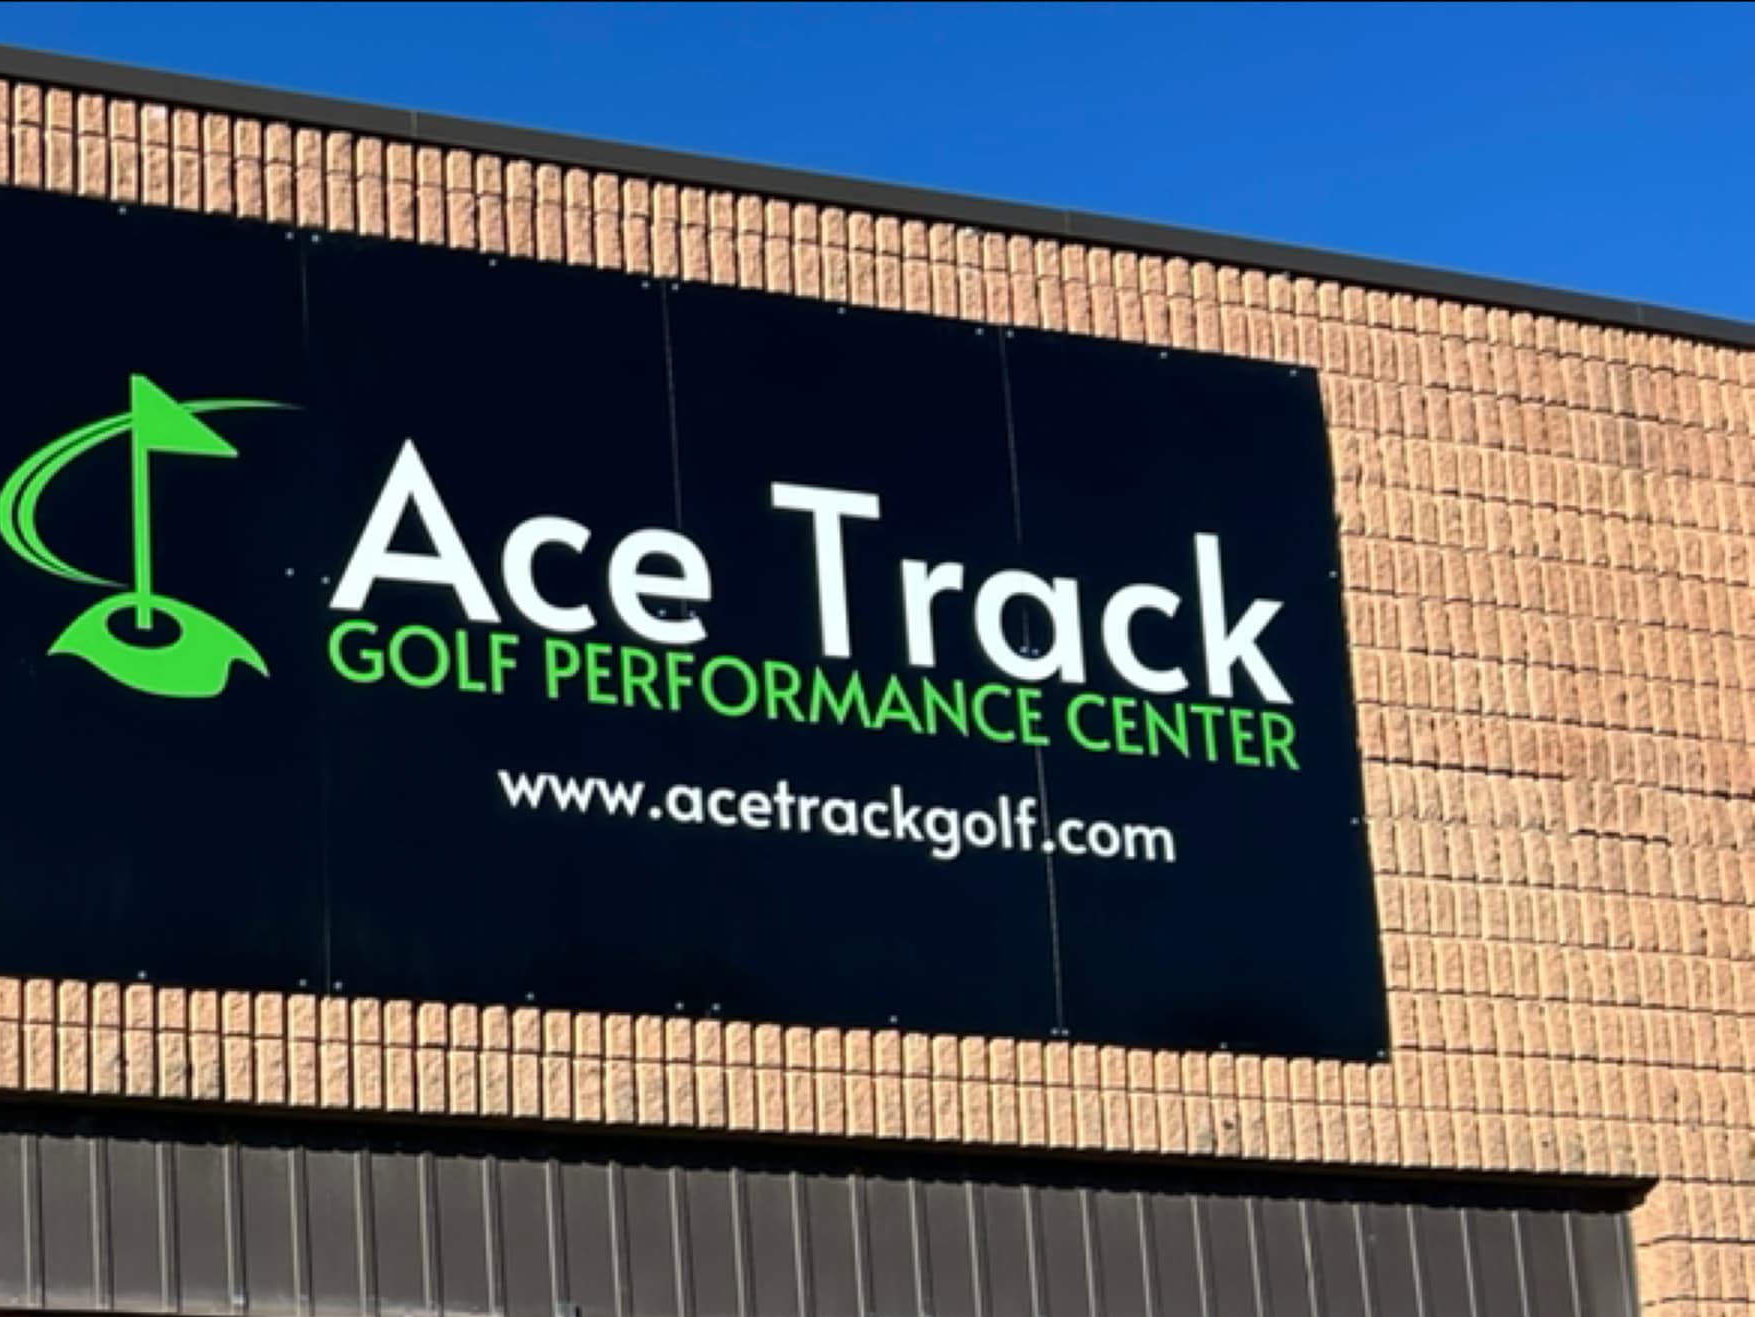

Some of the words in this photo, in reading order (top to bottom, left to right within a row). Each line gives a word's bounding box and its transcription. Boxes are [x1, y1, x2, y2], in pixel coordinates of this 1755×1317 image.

[329, 439, 713, 645] Ace
[771, 482, 1295, 704] Track
[328, 619, 519, 695] GOLF
[544, 637, 1049, 748] PERFORMANCE
[1066, 692, 1301, 770] CENTER
[497, 769, 1177, 864] www.acetrackgolf.com
